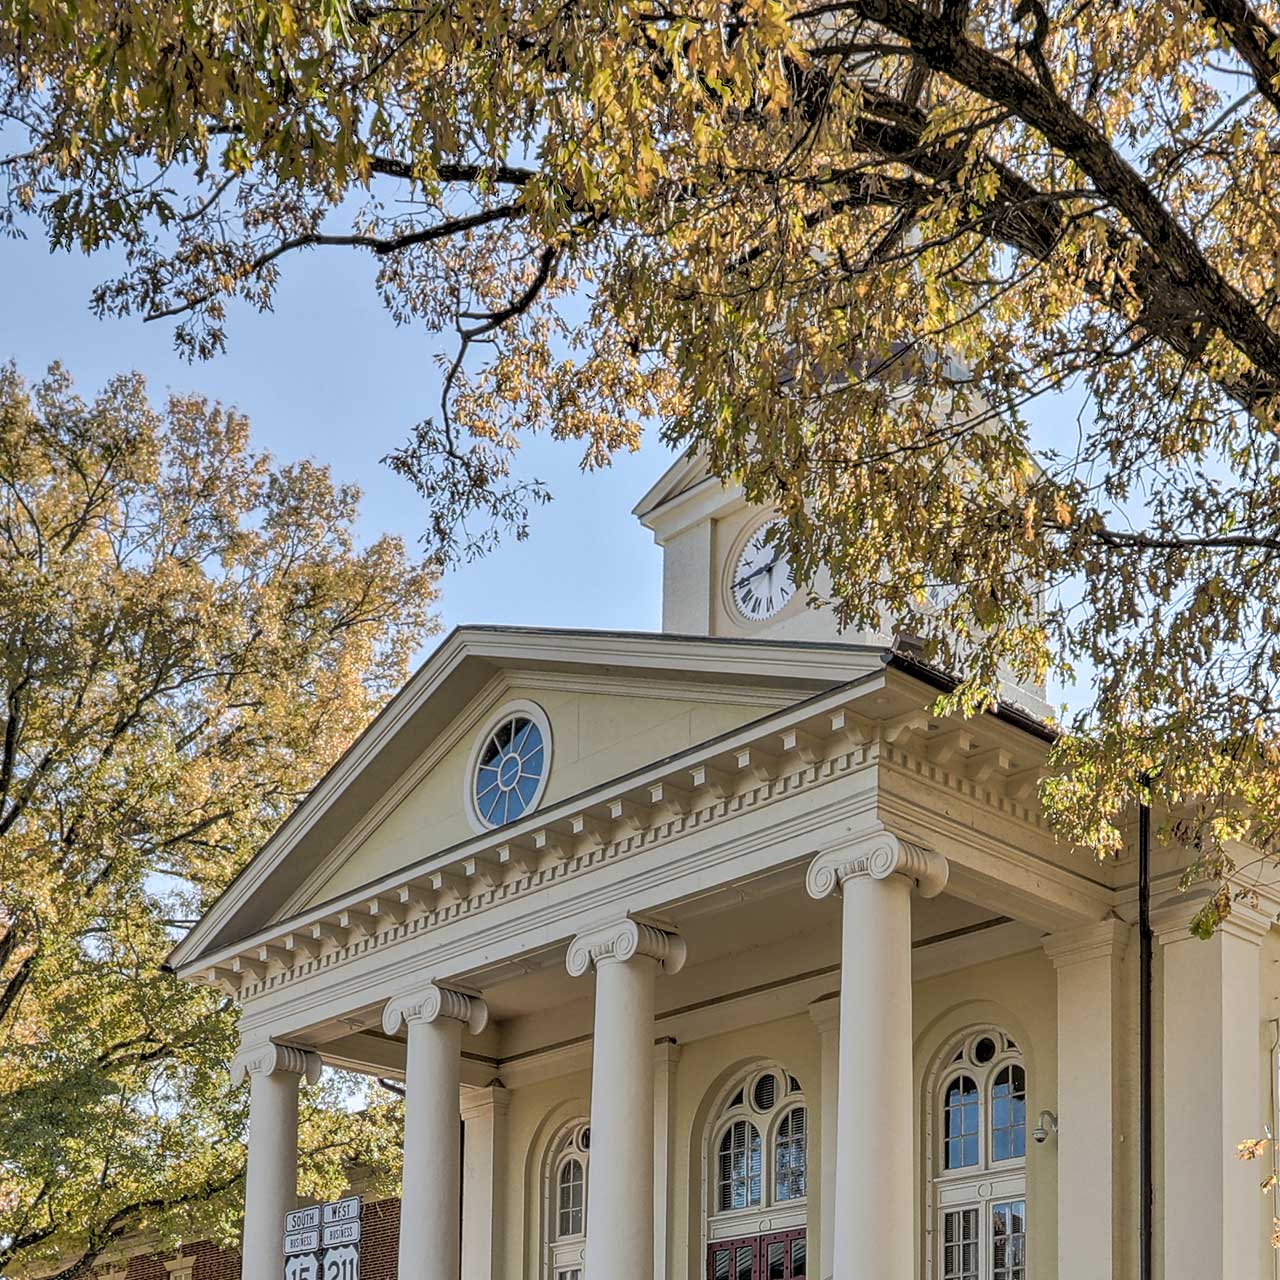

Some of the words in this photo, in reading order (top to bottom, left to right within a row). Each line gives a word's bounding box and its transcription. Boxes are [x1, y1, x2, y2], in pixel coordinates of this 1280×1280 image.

[331, 1204, 351, 1220] WEST
[291, 1212, 315, 1228] SOUTH
[329, 1226, 353, 1240] BUSINESS
[290, 1235, 312, 1249] BUSINESS
